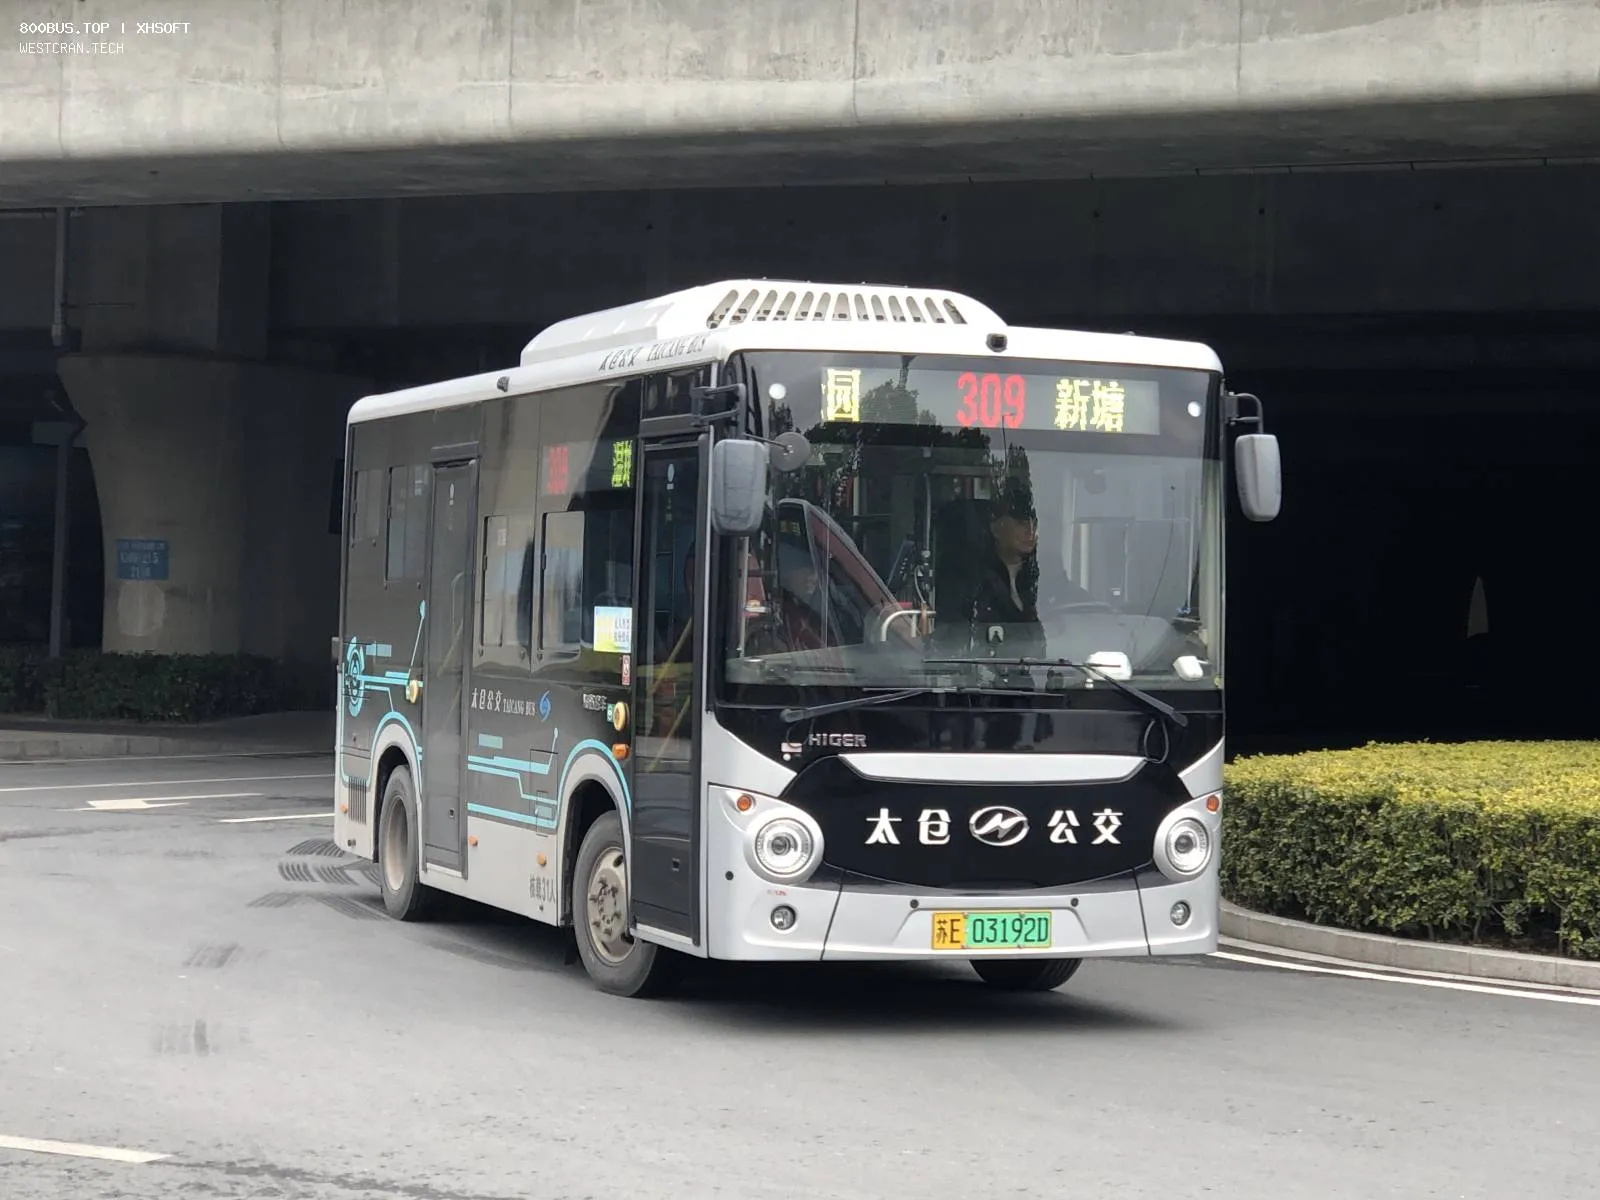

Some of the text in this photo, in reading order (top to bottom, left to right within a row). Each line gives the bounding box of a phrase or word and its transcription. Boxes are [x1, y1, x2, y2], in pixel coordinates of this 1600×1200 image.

[956, 371, 1026, 429] 309
[1054, 378, 1125, 432] 新塘
[471, 687, 504, 712] 太仓公交
[808, 733, 867, 747] HIGER
[864, 807, 1124, 846] 太仓 公交
